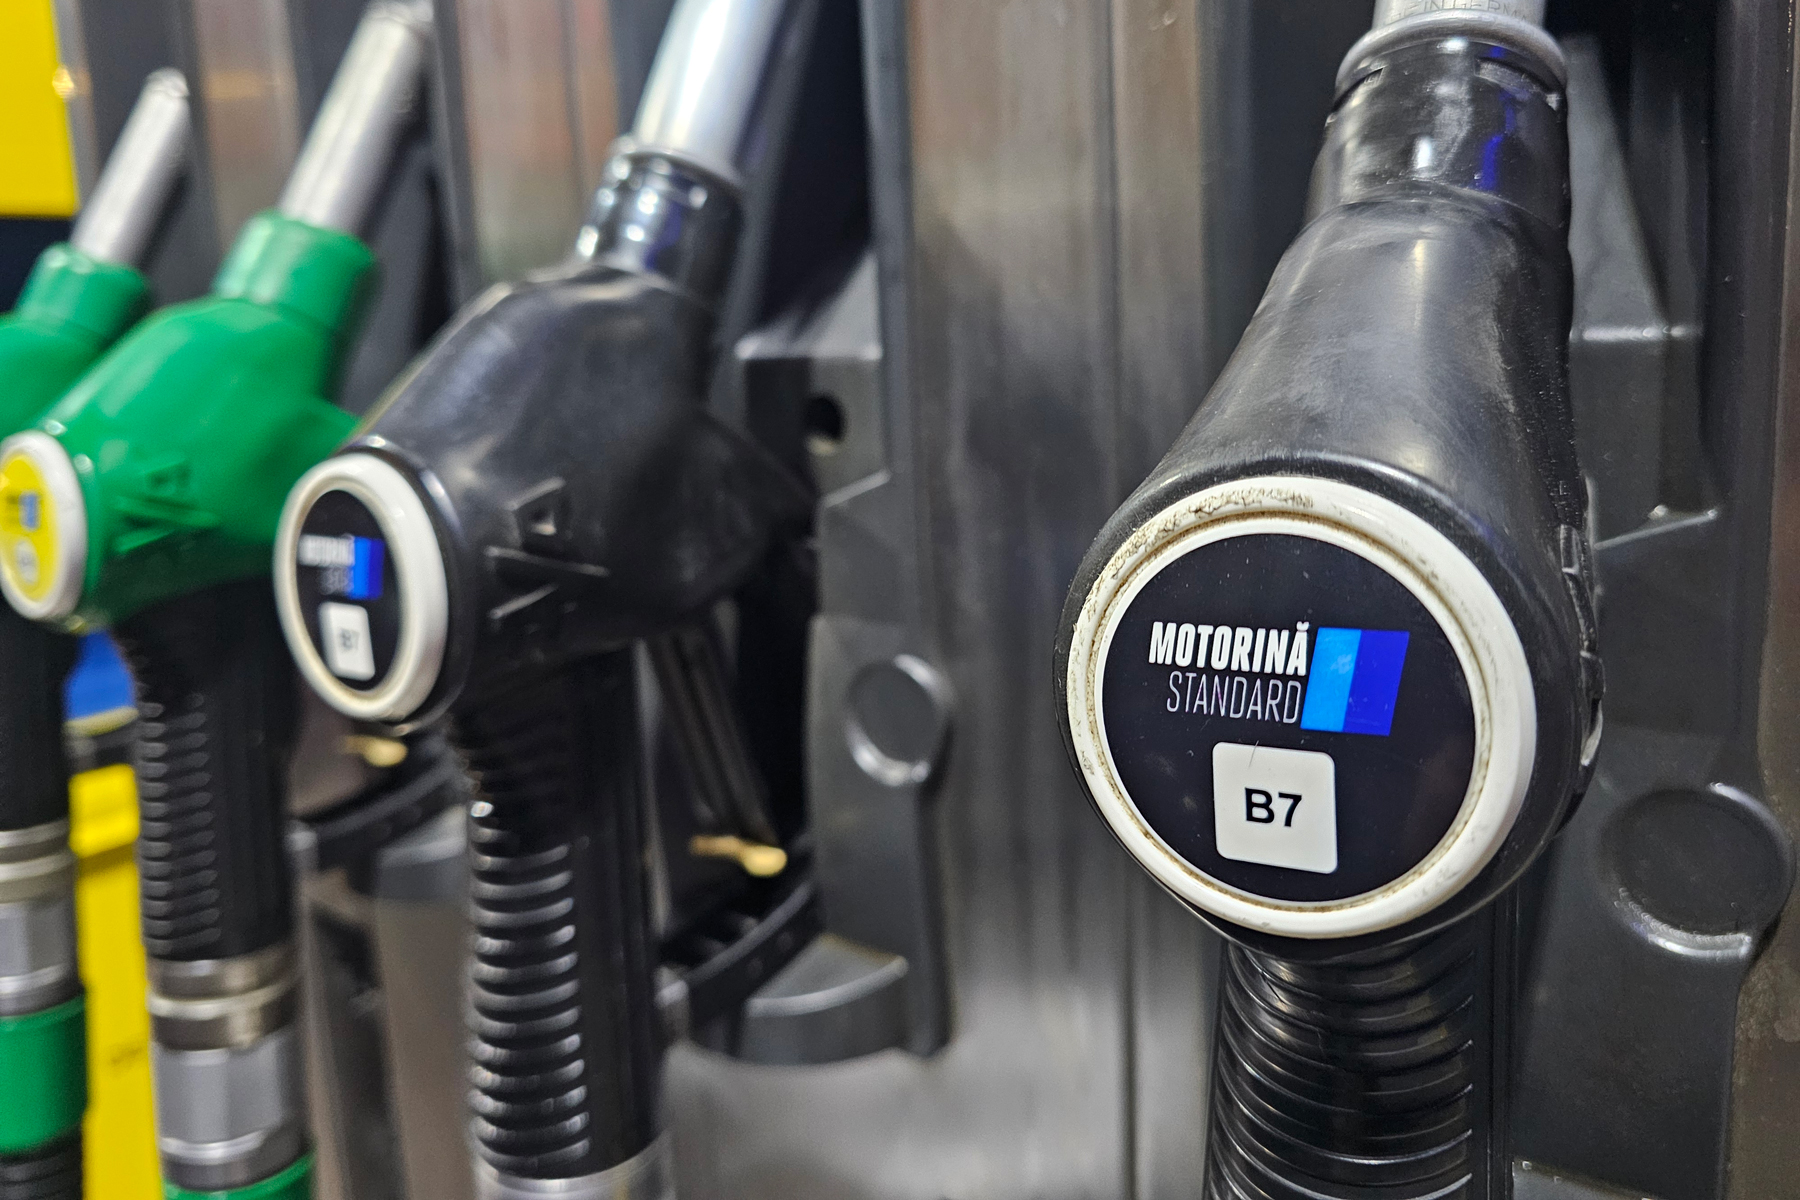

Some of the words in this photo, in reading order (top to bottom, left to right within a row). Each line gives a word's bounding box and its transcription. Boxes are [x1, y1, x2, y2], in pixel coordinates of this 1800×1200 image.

[1148, 621, 1310, 677] MOTORINĂ
[1166, 670, 1303, 724] STANDARD
[1244, 787, 1303, 828] B7
